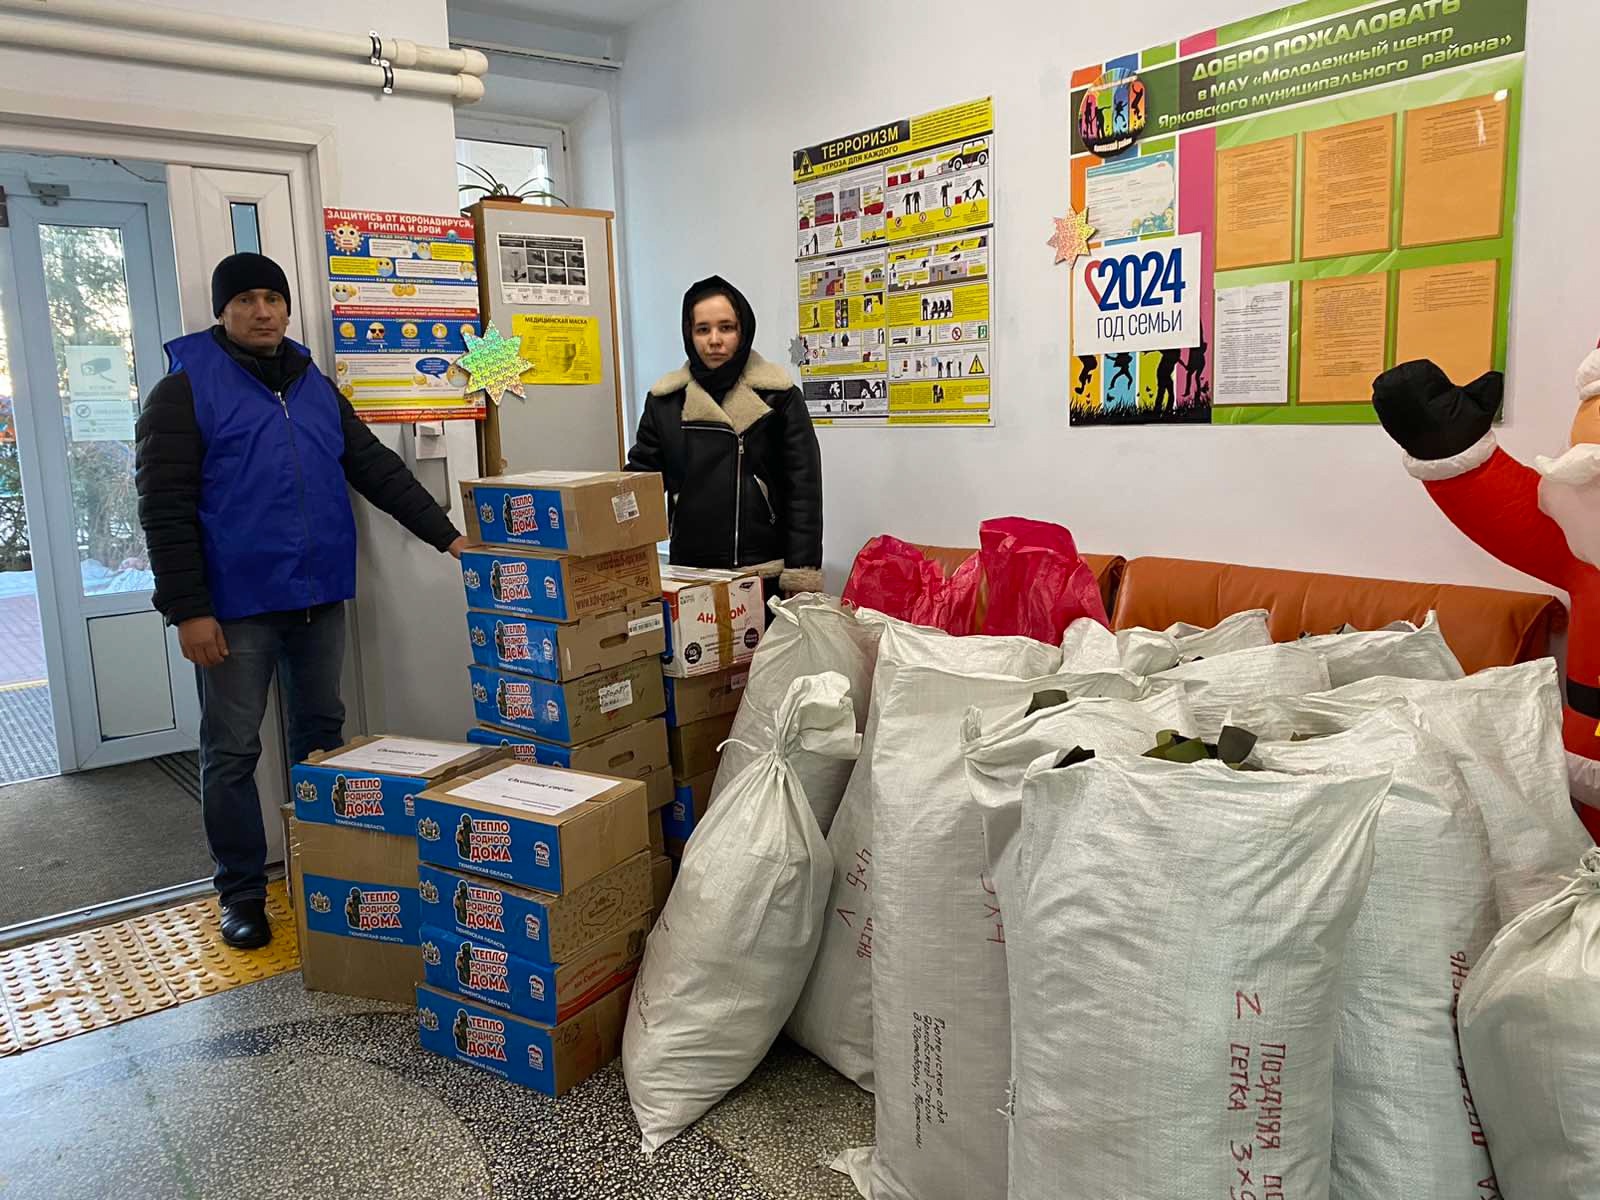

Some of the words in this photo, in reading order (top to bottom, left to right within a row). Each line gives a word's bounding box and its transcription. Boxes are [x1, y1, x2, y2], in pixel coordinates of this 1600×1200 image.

[1192, 45, 1269, 82] ДОБРО
[1274, 0, 1462, 58] ПОЖАЛОВАТЬ
[1197, 88, 1206, 101] в
[1210, 76, 1249, 98] МАУ
[1393, 26, 1454, 54] центр
[1158, 98, 1248, 129] Ярковского
[1251, 59, 1408, 107] муниципального
[1422, 34, 1513, 69] района»
[821, 125, 899, 160] ТЕРРОРИЗМ
[821, 155, 847, 171] УГРОЗА
[848, 154, 863, 167] ДЛЯ
[864, 145, 899, 161] КАЖДОГО
[327, 210, 383, 223] ЗАЩИТИСЬ
[385, 214, 397, 223] ОТ
[368, 222, 405, 233] ГРИППА
[417, 224, 441, 234] ОРВИ
[1098, 248, 1186, 311] 2024
[524, 316, 569, 325] МЕДИЦИНСКАЯ
[1097, 315, 1125, 342] ГОД
[511, 495, 533, 507] ТЕПЛО
[513, 517, 538, 534] ДОМА
[502, 563, 527, 574] ТЕПЛО
[502, 586, 530, 601] ДОМА
[505, 646, 530, 661] ДОМА
[507, 705, 534, 720] ДОМА
[348, 779, 380, 789] ТЕПЛО
[345, 791, 382, 802] РОДНОГО
[346, 802, 384, 817] ДОМА
[474, 820, 509, 833] ТЕПЛО
[470, 834, 510, 846] РОДНОГО
[471, 846, 512, 863] ДОМА
[363, 892, 399, 902] ТЕПЛО
[470, 888, 502, 903] ТЕПЛО
[360, 904, 400, 914] РОДНОГО
[466, 901, 503, 914] РОДНОГО
[361, 915, 401, 930] ДОМА
[467, 913, 504, 932] ДОМА
[474, 949, 507, 963] ТЕПЛО
[470, 962, 508, 975] РОДНОГО
[471, 974, 509, 992] ДОМА
[471, 1017, 504, 1031] ТЕПЛО
[467, 1029, 505, 1045] РОДНОГО
[468, 1041, 507, 1061] ДОМА
[1255, 1043, 1287, 1149] ПОЗДНЯЯ
